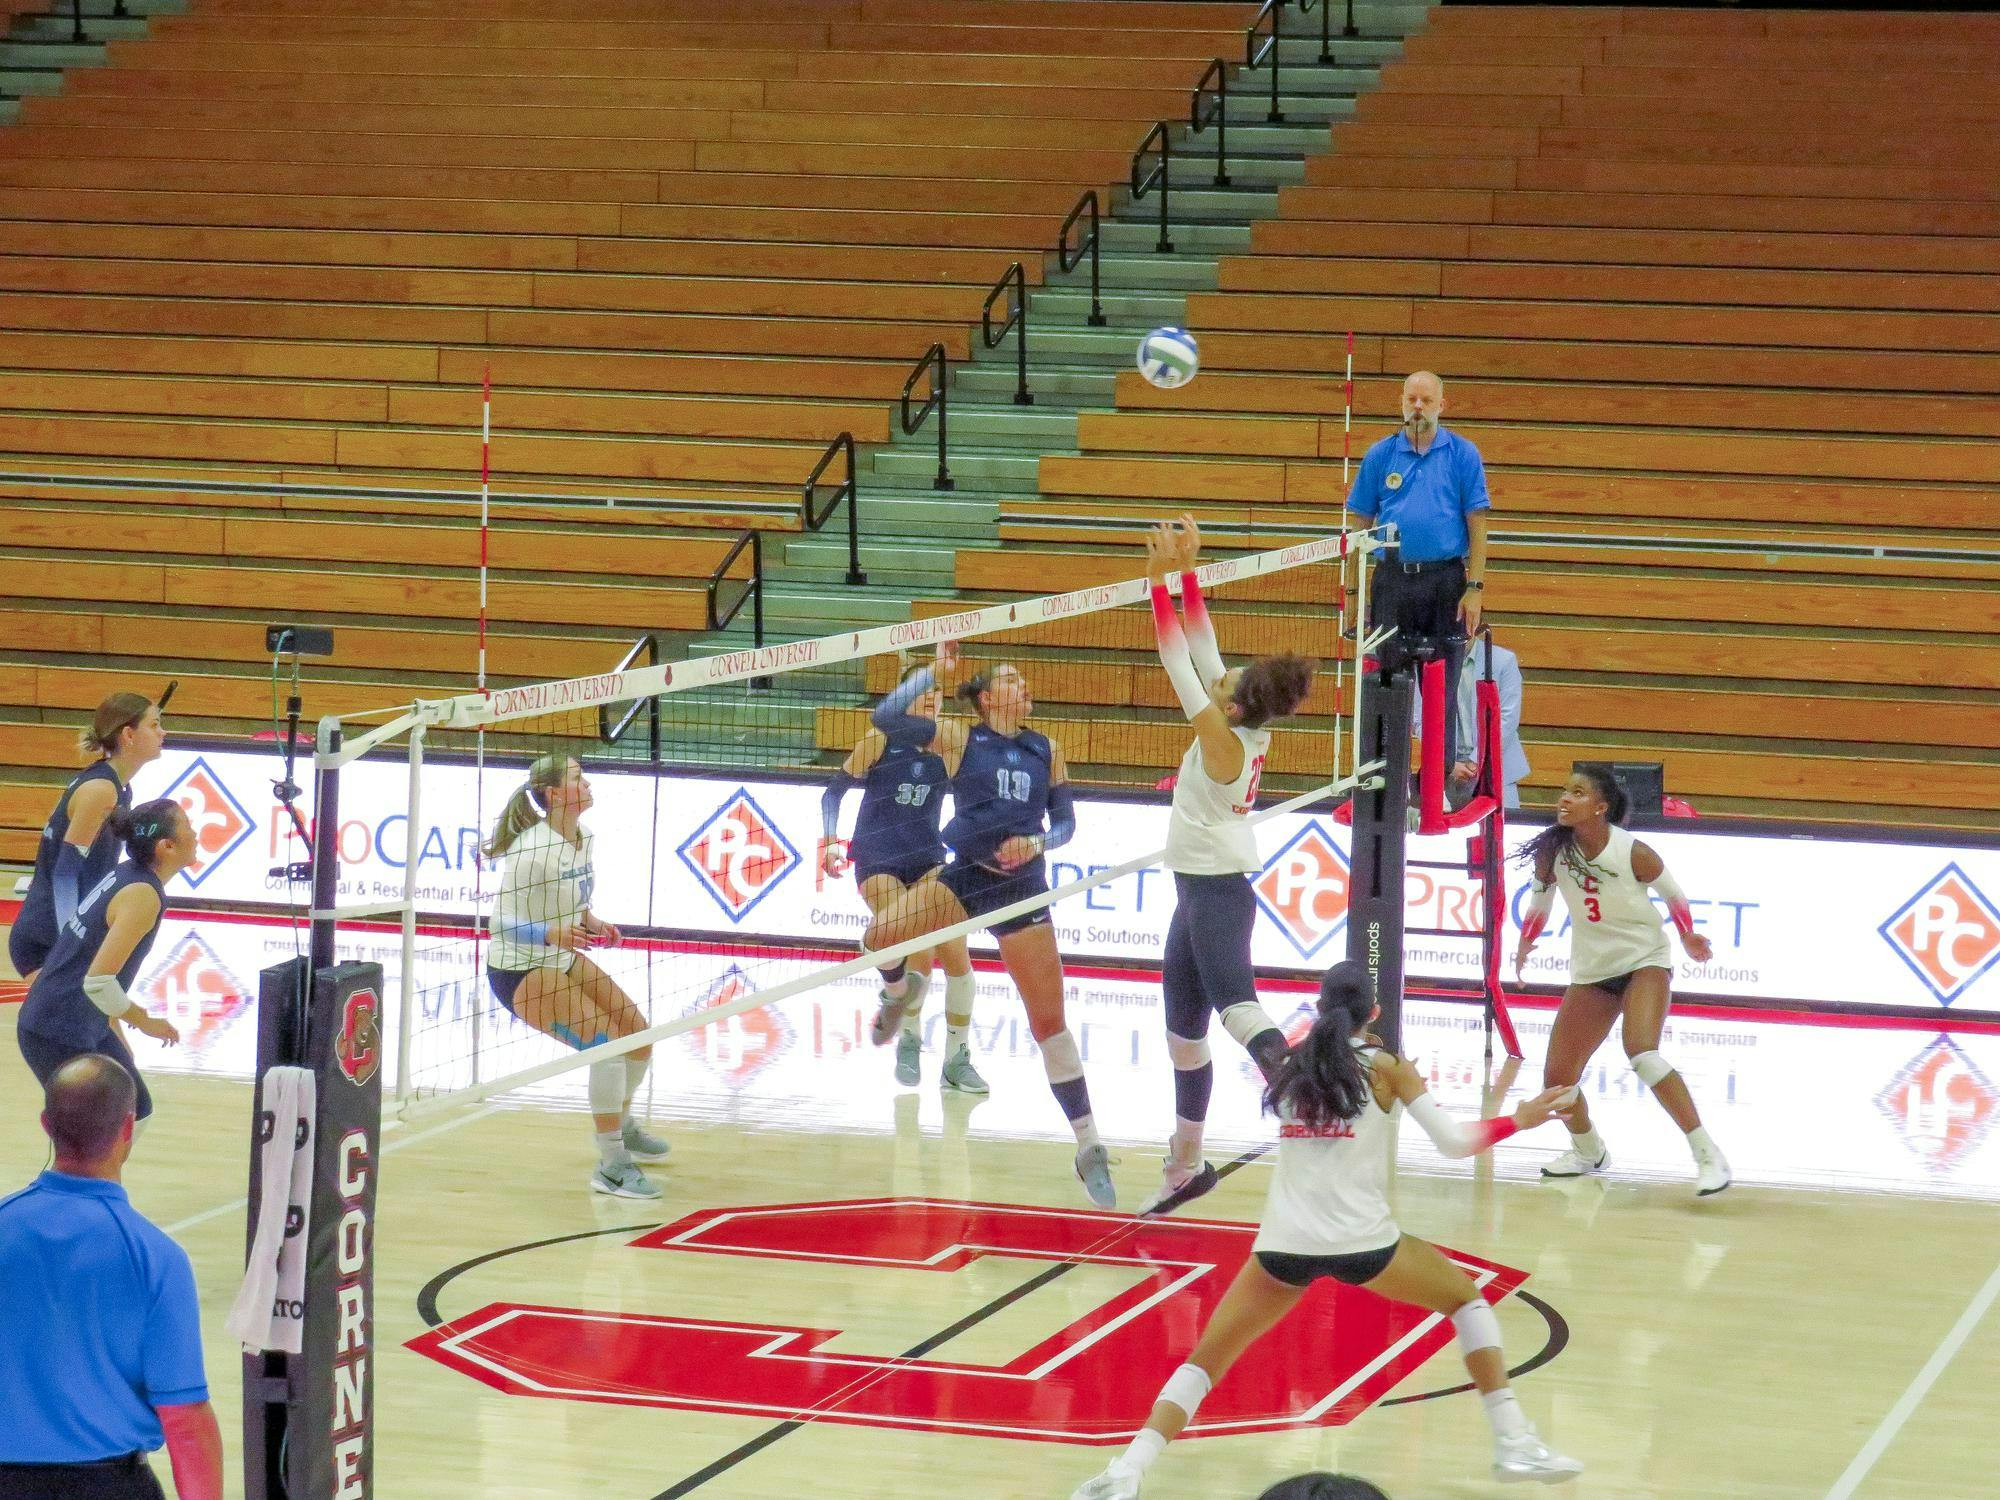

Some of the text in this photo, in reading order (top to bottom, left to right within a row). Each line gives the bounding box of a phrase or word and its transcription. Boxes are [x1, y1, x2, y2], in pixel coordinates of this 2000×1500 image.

[890, 612, 981, 645] CORNELL UNIVERSITY
[709, 641, 820, 677] CORNELL UNIVERSITY
[494, 674, 626, 716] CORNELL UNIVERSITY
[708, 818, 771, 898] PC
[357, 881, 367, 896] &
[1277, 850, 1344, 934] PC
[1584, 898, 1601, 923] 3
[1087, 926, 1160, 946] Solutions
[1367, 922, 1380, 966] sports
[1913, 893, 1985, 980] PC
[1681, 960, 1760, 983] Solutions
